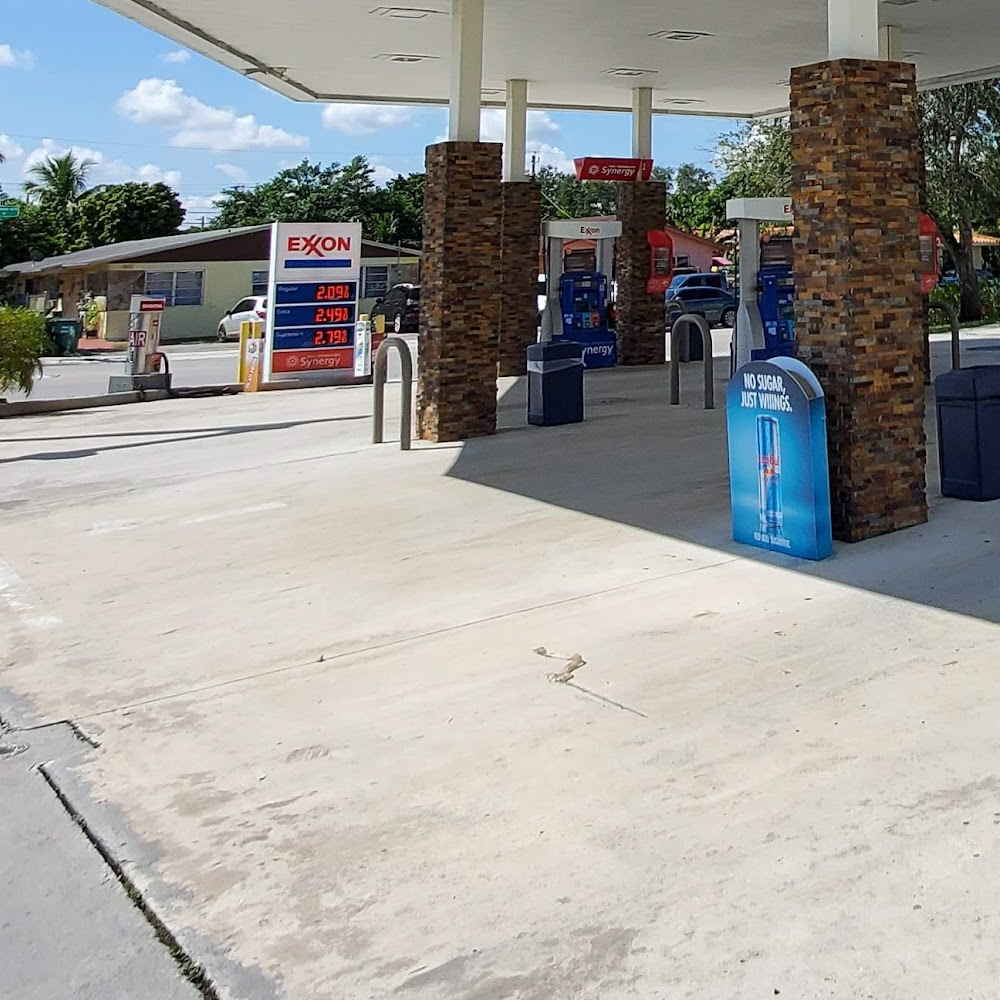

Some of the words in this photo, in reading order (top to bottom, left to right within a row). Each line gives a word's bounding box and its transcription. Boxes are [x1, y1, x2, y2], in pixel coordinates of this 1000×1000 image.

[601, 166, 635, 177] Synergy
[580, 226, 600, 236] Exxon
[287, 234, 351, 258] EXXON
[129, 331, 146, 347] AIR
[300, 356, 341, 369] Synergy
[743, 372, 756, 389] NO
[757, 374, 786, 395] SUGAR,
[741, 391, 757, 408] JUST
